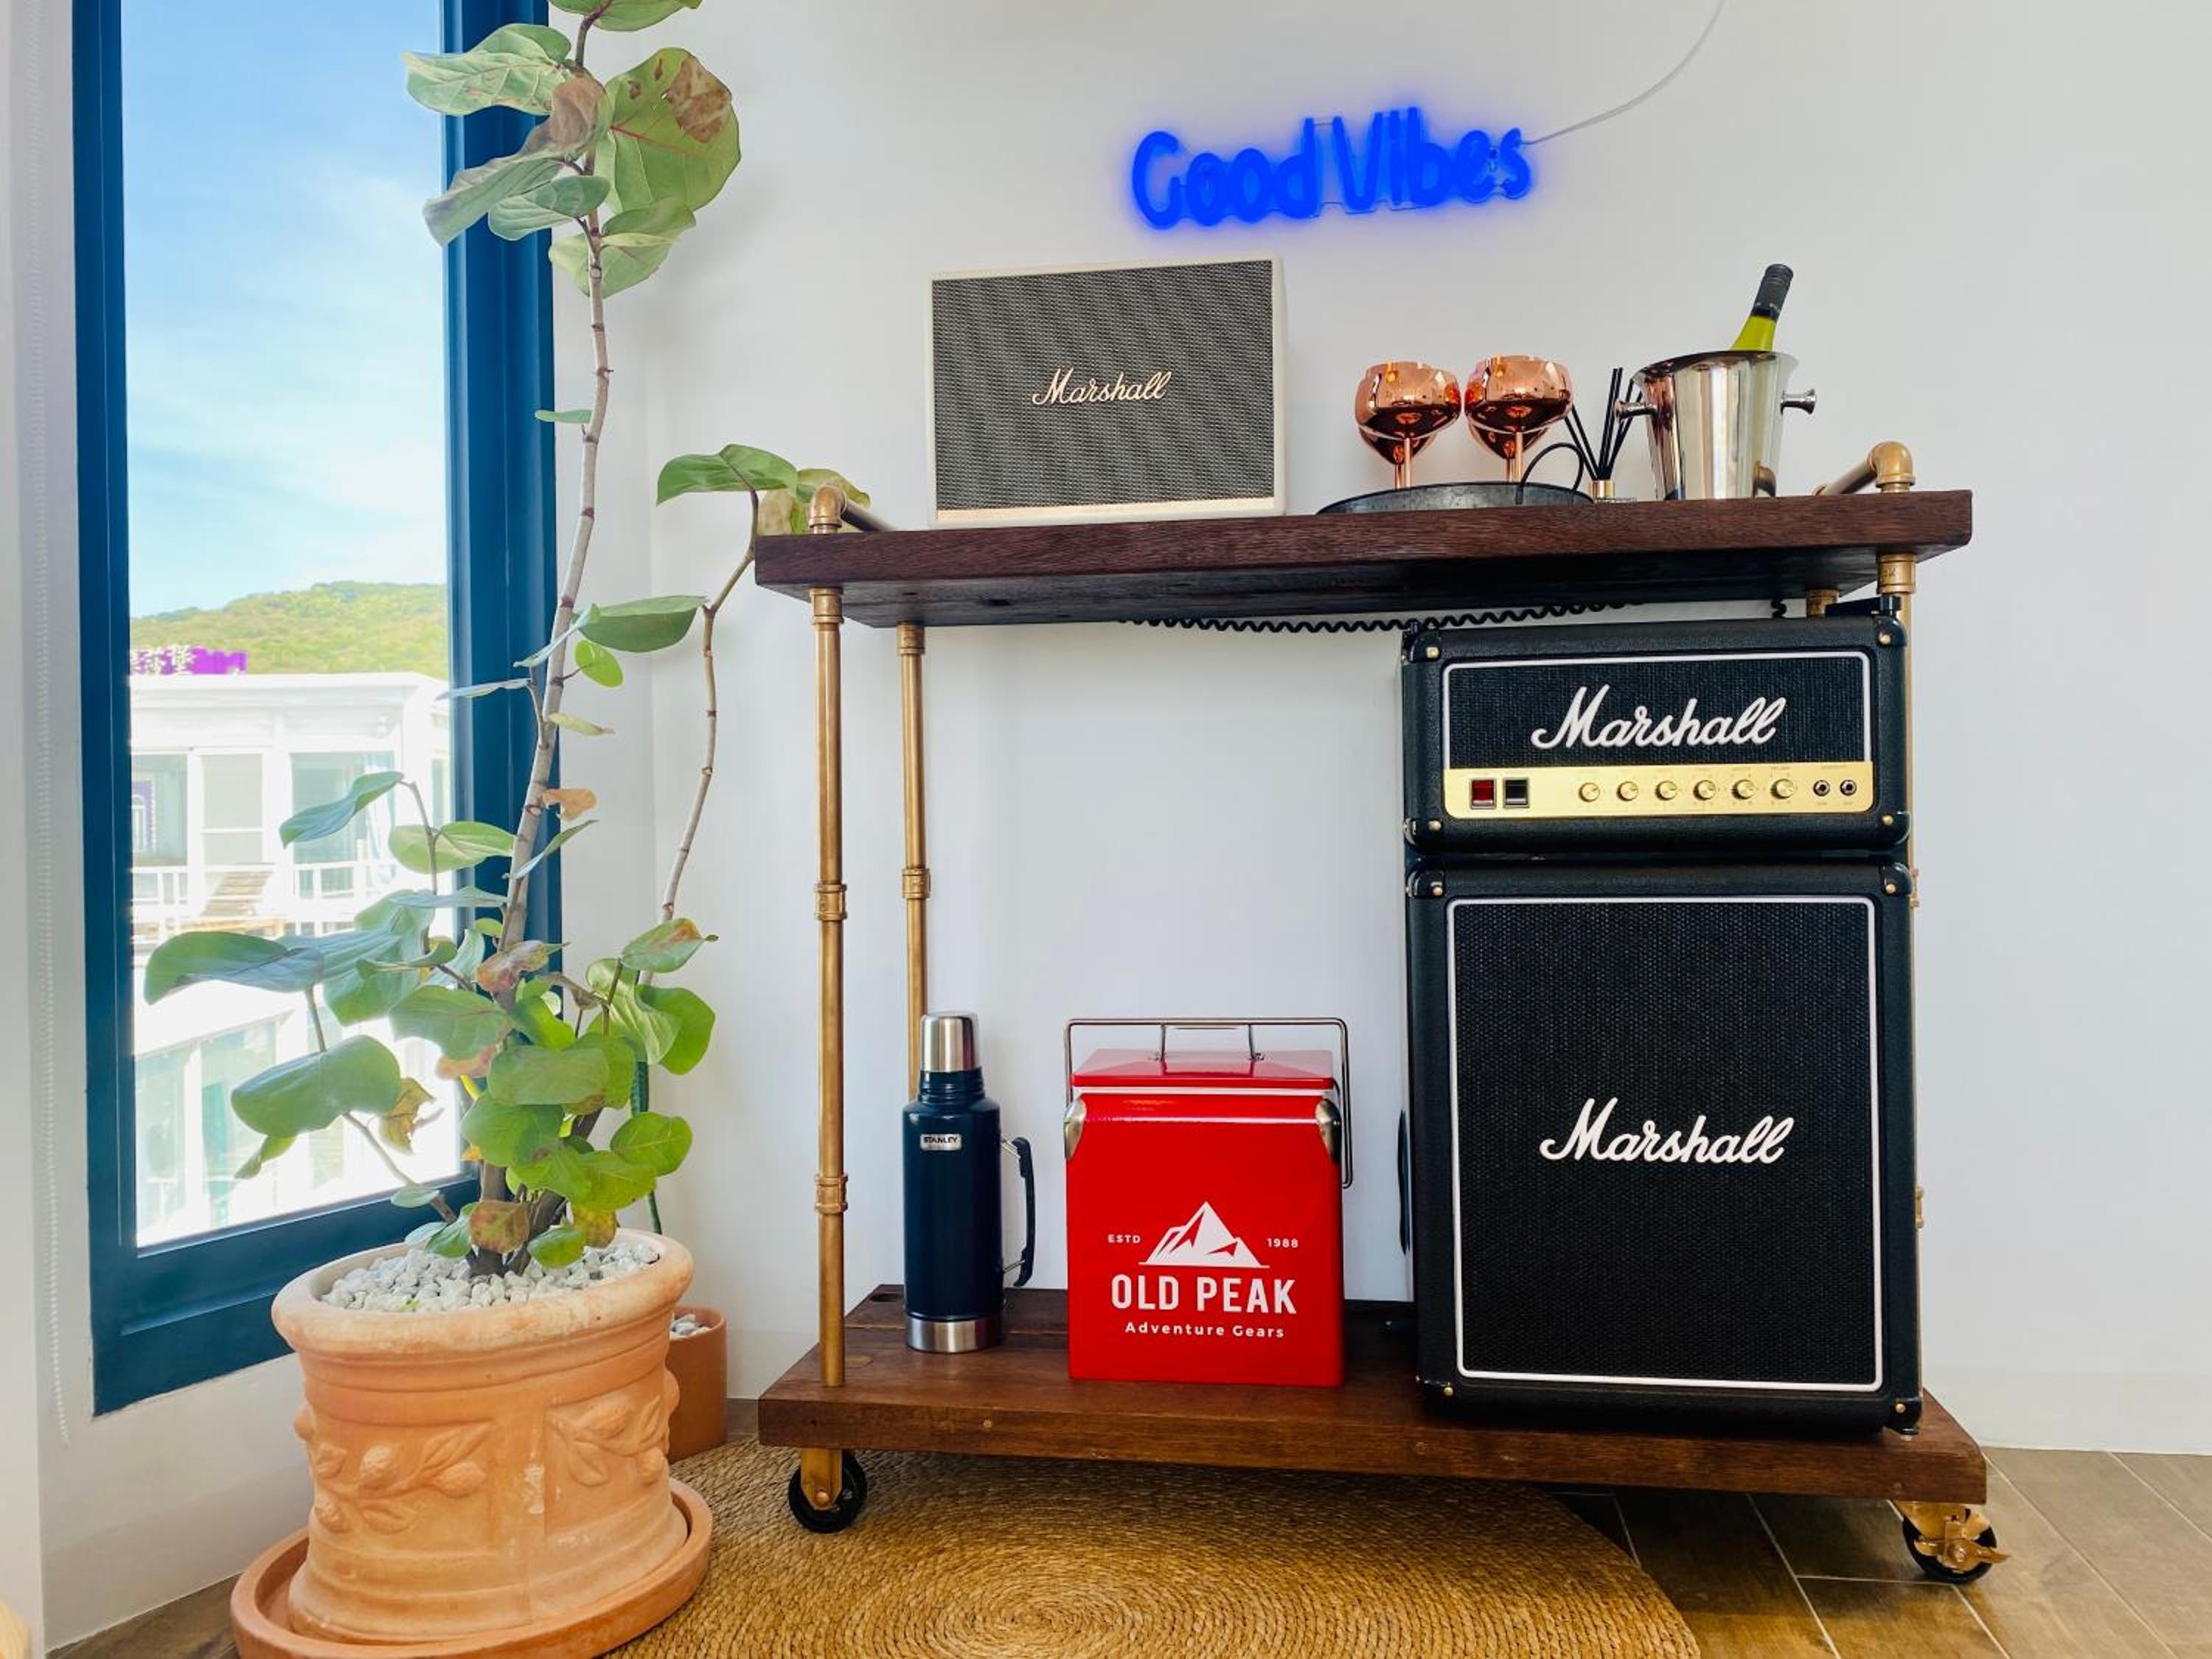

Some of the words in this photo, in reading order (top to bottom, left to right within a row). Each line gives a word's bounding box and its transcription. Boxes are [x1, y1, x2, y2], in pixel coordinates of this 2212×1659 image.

[1131, 116, 1319, 230] Good
[1331, 105, 1531, 215] Vibes
[1032, 367, 1172, 405] Marshall
[1531, 684, 1787, 749] Marshall
[1539, 1096, 1795, 1164] Marshall
[1107, 1234, 1141, 1244] ESTD
[1267, 1238, 1298, 1248] 1988
[1111, 1273, 1179, 1310] OLD
[1197, 1276, 1297, 1315] PEAK
[1125, 1321, 1225, 1336] Adventure
[1232, 1325, 1284, 1338] Gears
